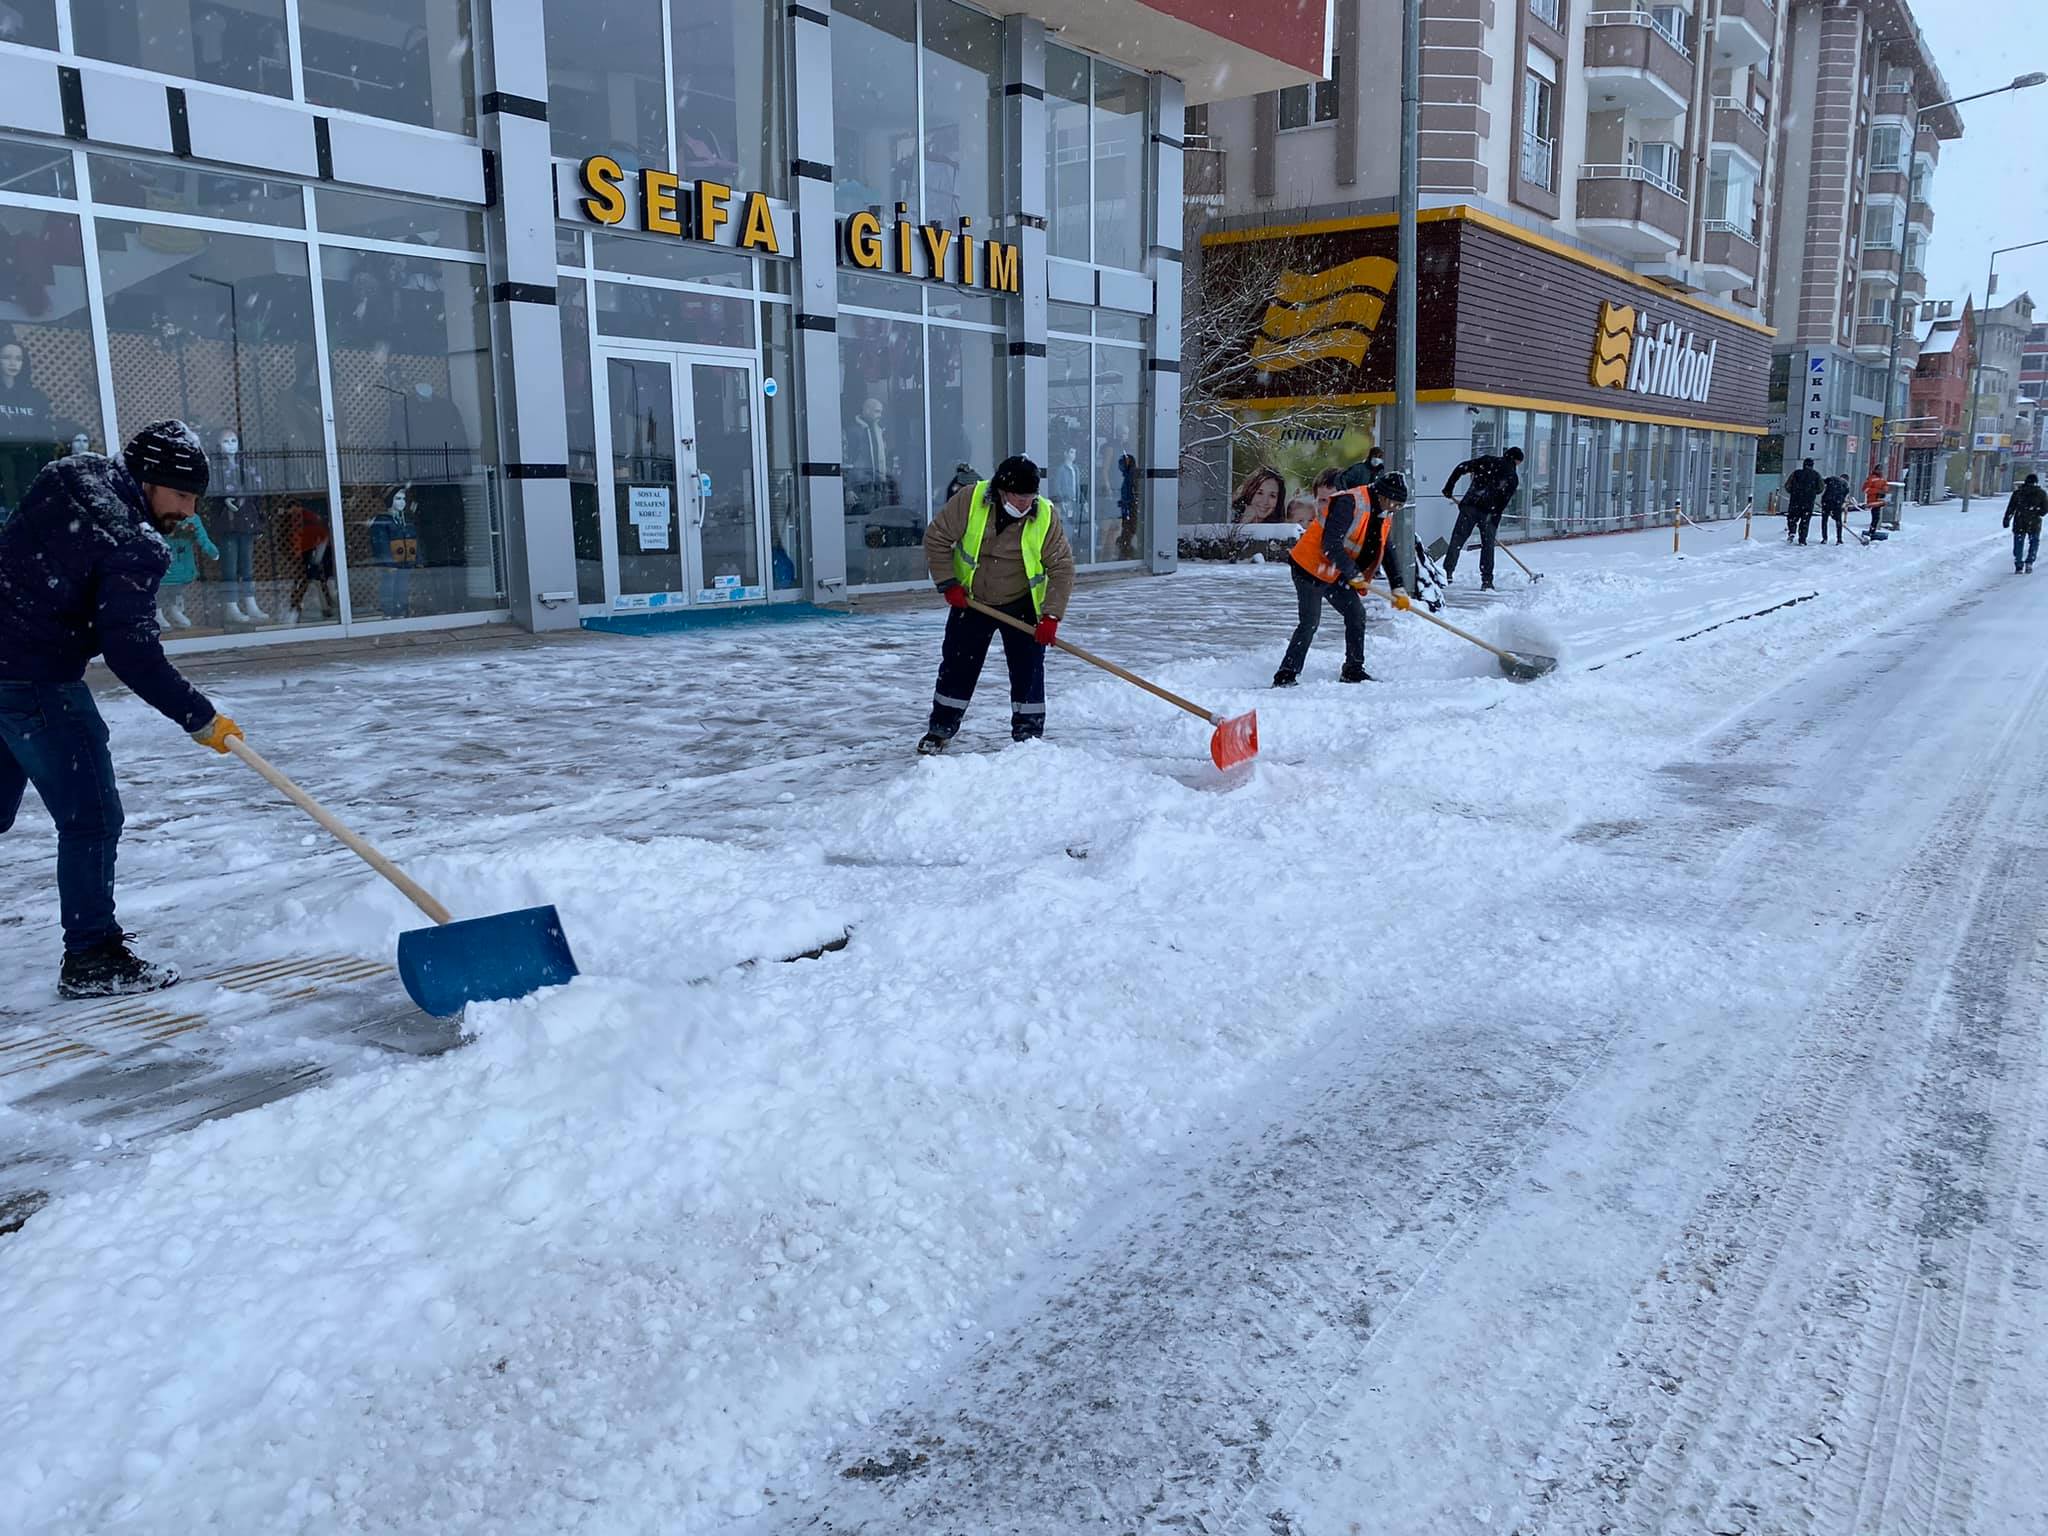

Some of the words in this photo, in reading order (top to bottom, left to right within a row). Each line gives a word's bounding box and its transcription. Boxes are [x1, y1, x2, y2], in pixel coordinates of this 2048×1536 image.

[580, 155, 779, 253] SEFA
[845, 201, 1018, 293] GİYİM
[1627, 311, 1718, 404] istikbal
[1808, 377, 1823, 451] KARGI
